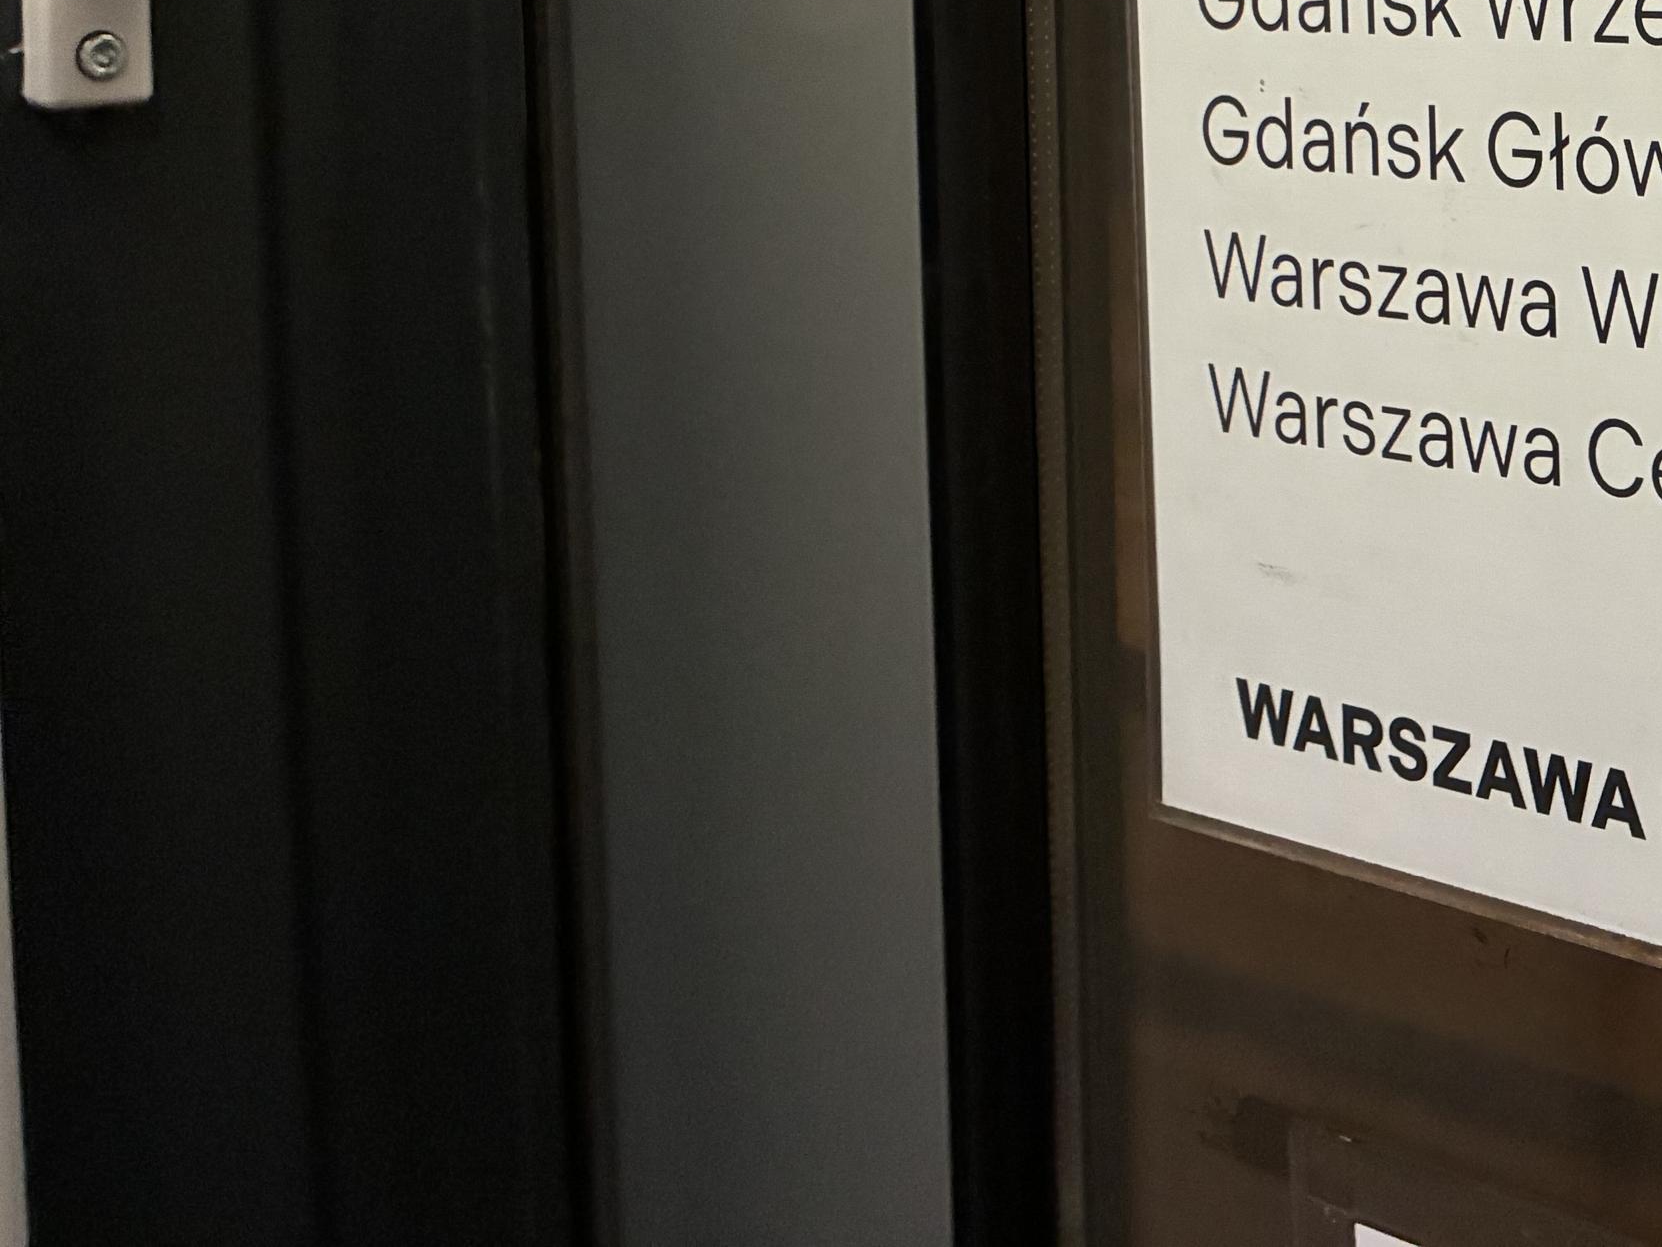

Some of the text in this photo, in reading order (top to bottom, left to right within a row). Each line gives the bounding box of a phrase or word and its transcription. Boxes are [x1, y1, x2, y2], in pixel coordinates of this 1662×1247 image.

[1201, 93, 1467, 184] Gdańsk
[1203, 228, 1558, 340] Warszawa
[1206, 361, 1562, 488] Warszawa
[1234, 675, 1648, 842] WARSZAWA
